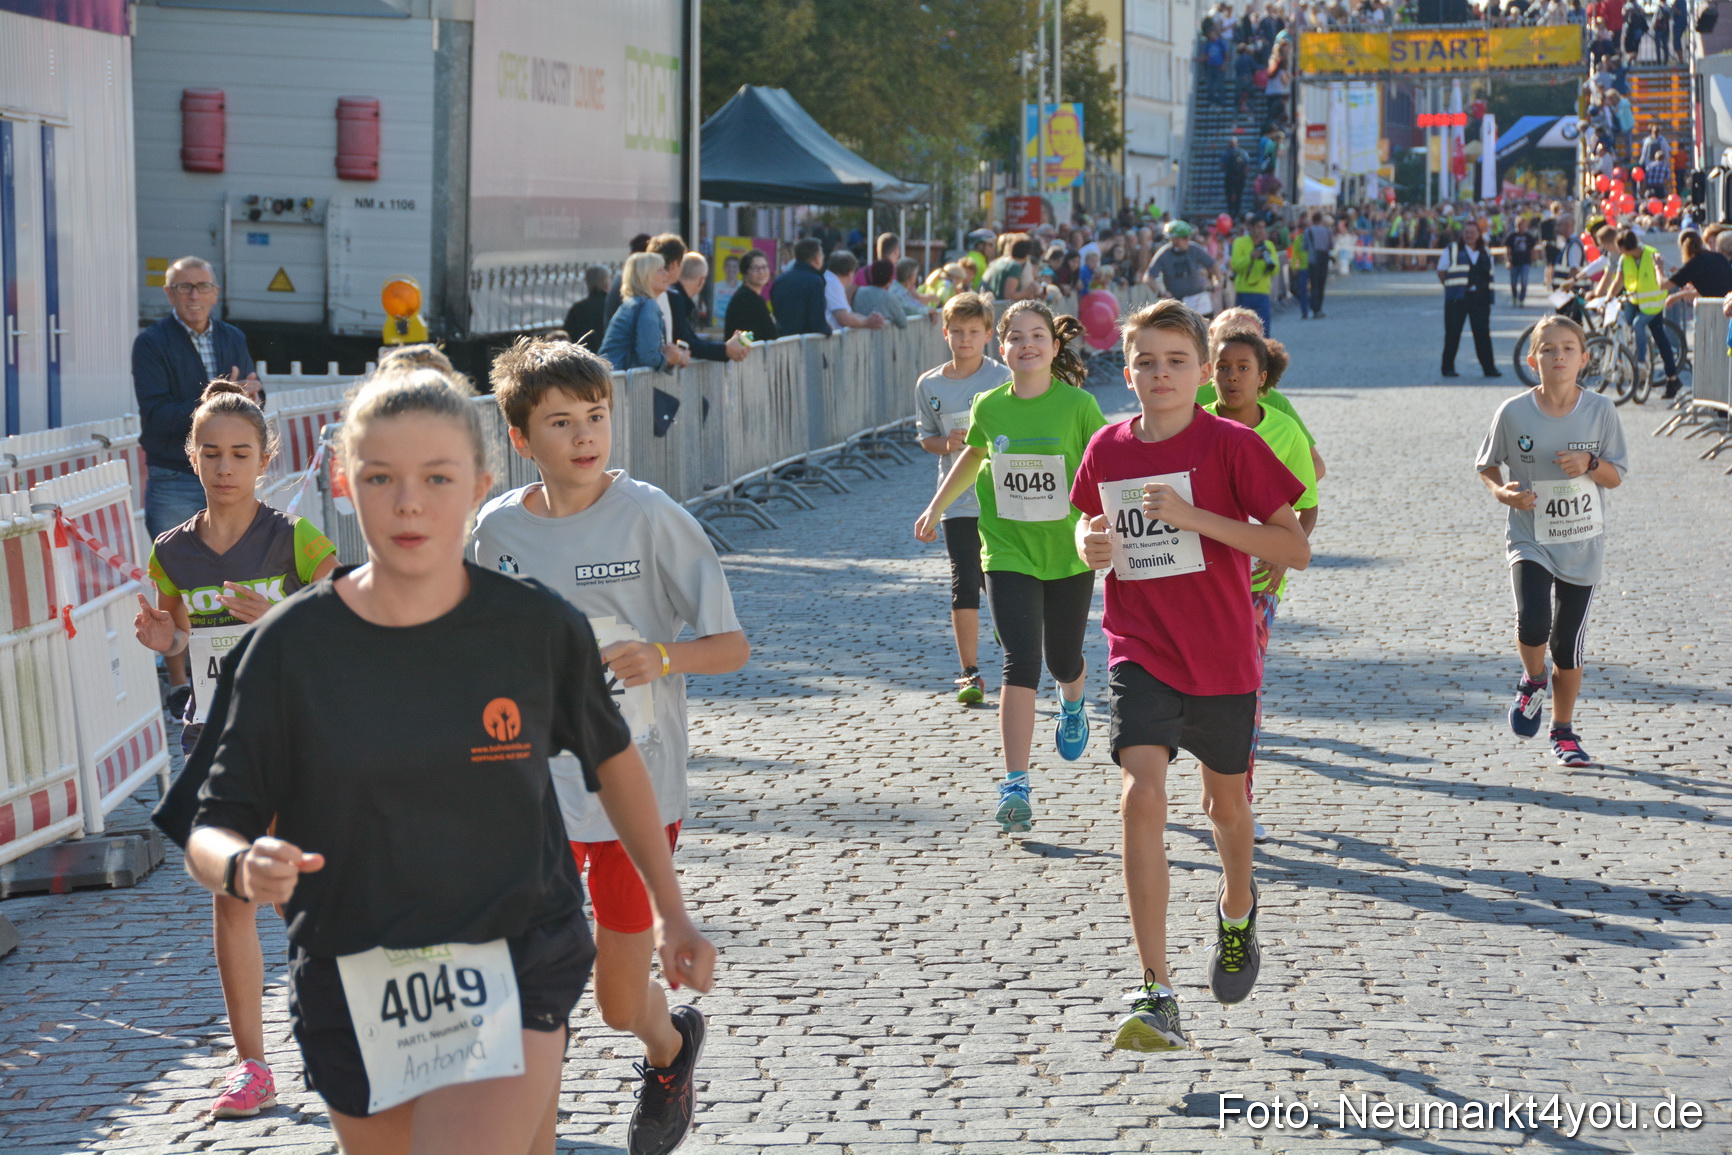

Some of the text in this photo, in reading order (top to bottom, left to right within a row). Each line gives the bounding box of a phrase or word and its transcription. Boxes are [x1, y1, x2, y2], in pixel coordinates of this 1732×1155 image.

[1391, 37, 1487, 62] START
[497, 50, 606, 112] OFFICE INDUSTRY LOUNGE
[624, 44, 680, 154] BOCK
[355, 198, 374, 208] NM
[391, 199, 416, 210] 1106
[1568, 441, 1600, 451] BOCK
[1003, 472, 1056, 493] 4048
[1545, 493, 1592, 518] 4012
[1549, 524, 1593, 538] Magdalena
[1122, 539, 1169, 550] PARTL Neumarkt
[575, 560, 640, 580] BOCK
[1128, 552, 1175, 569] Dominik
[381, 964, 488, 1028] 4049
[397, 1021, 469, 1049] PARTL Neumarkt
[402, 1040, 487, 1085] Antonia
